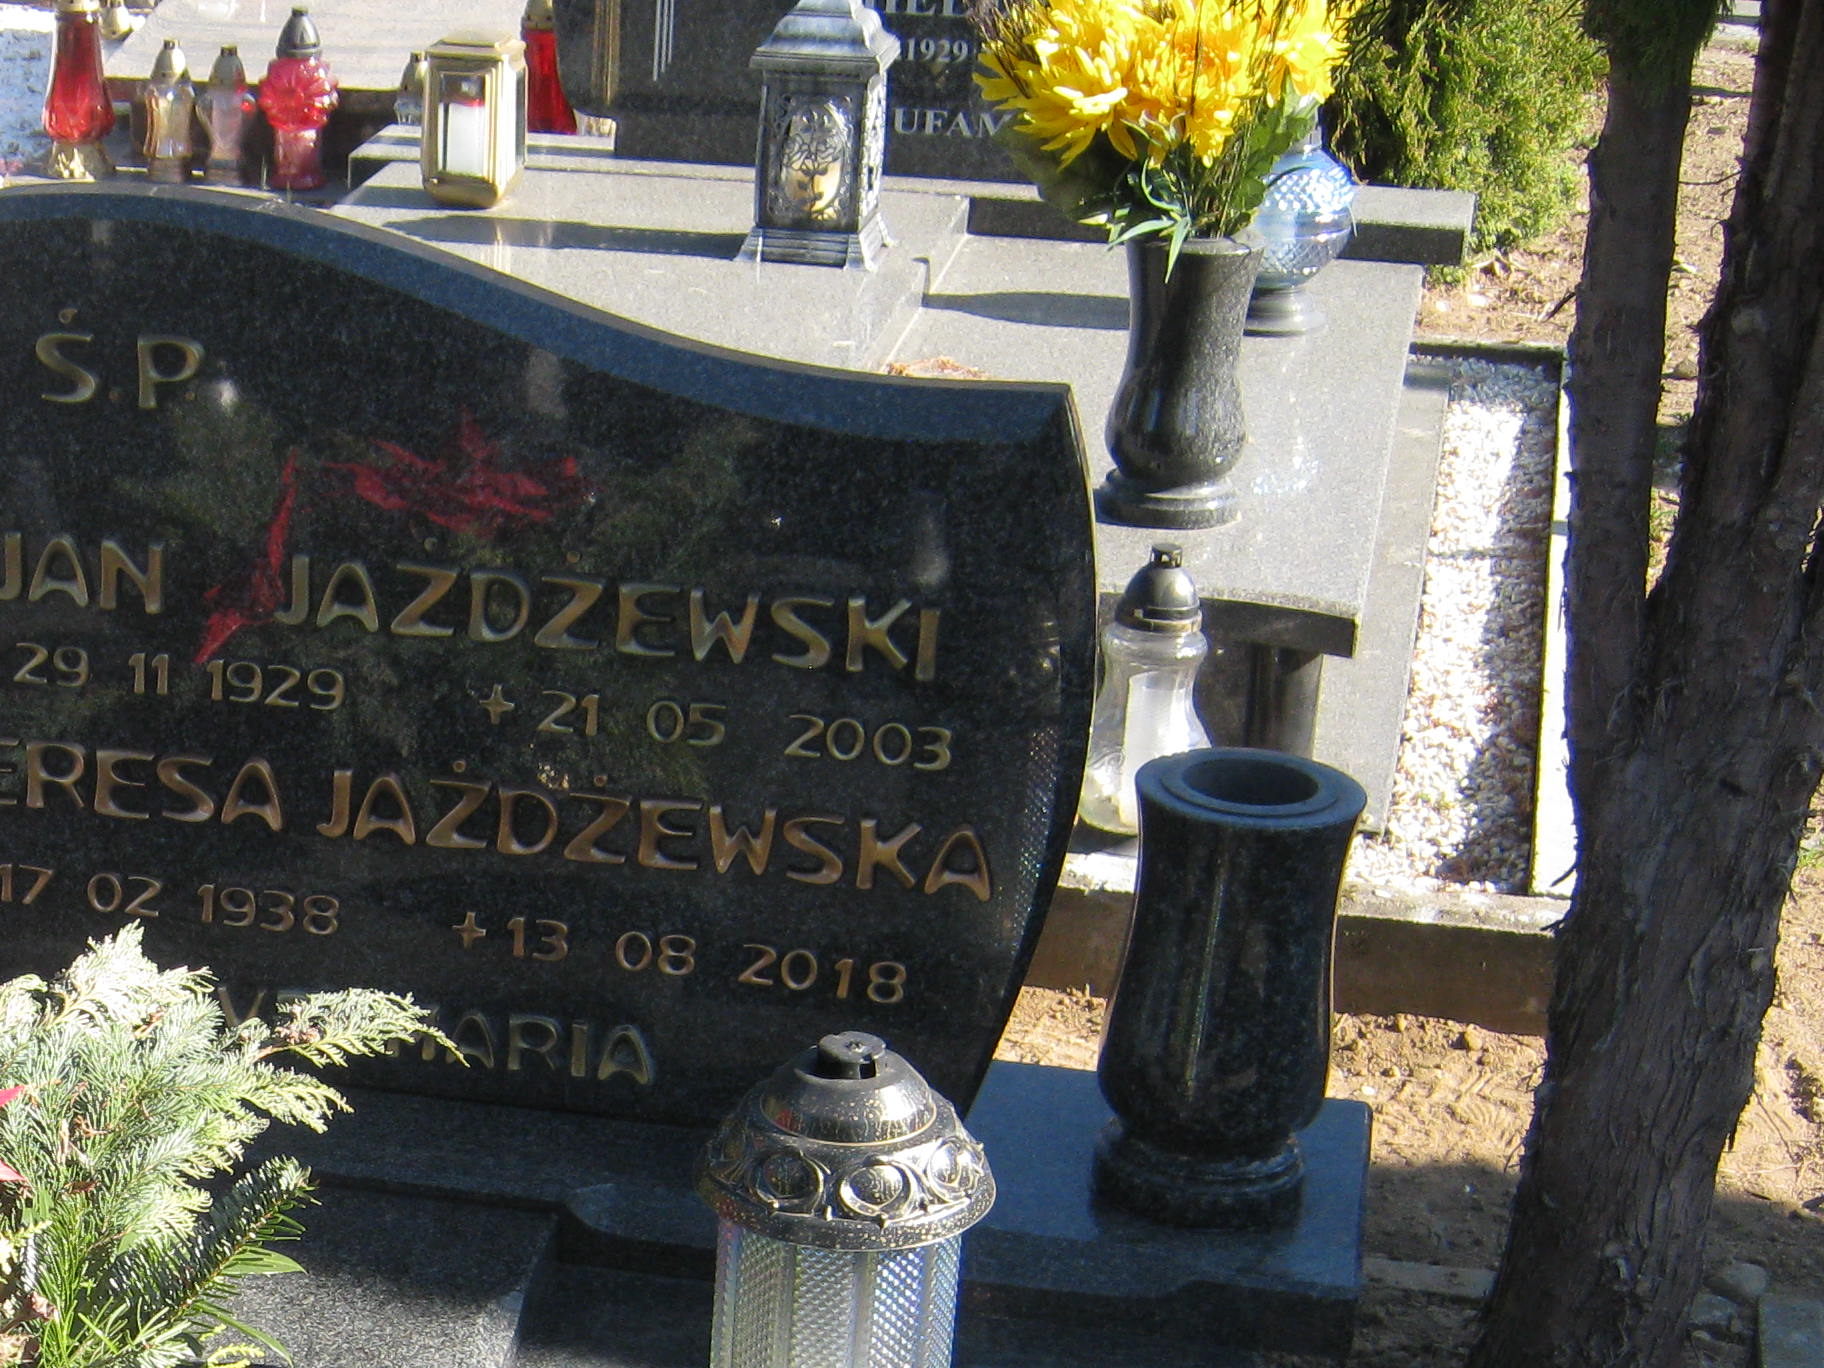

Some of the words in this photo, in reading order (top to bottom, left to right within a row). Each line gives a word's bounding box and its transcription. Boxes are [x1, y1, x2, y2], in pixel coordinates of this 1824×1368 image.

[275, 537, 941, 681] JAŻDŻEWSKI
[13, 642, 88, 687] 29
[128, 652, 169, 695] 11
[206, 658, 345, 710] 1929
[538, 691, 599, 736] 21
[646, 701, 726, 746] 05
[784, 714, 952, 771] 2003
[316, 760, 991, 901] JAŻDŻEWSKA
[87, 873, 161, 916] 02
[197, 884, 340, 935] 1938
[507, 917, 568, 961] 13
[615, 931, 696, 975] 08
[737, 944, 906, 1003] 2018
